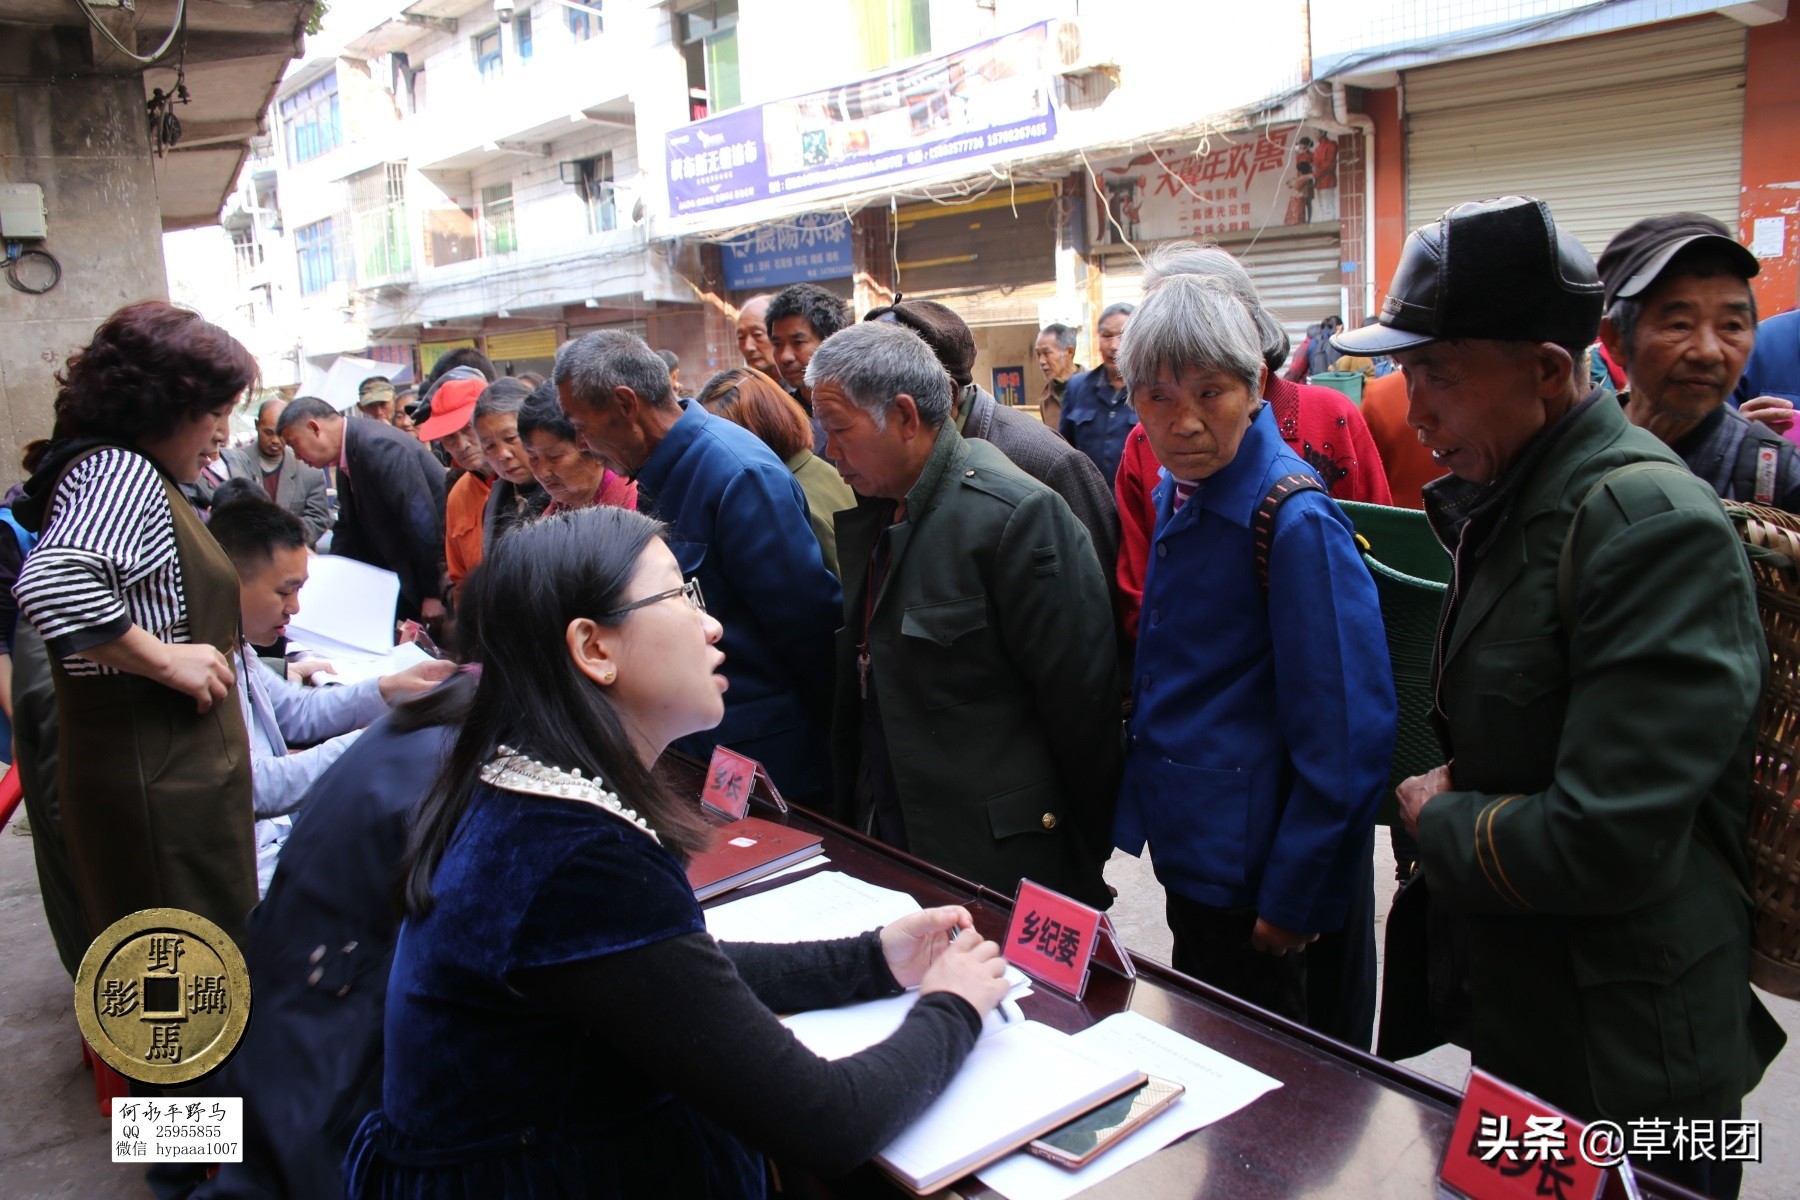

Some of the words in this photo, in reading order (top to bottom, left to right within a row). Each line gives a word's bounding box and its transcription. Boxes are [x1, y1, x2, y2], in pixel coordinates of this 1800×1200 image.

[1154, 126, 1298, 197] 天翼年欢惠
[711, 767, 743, 801] 乡长
[1018, 910, 1081, 969] 乡纪委
